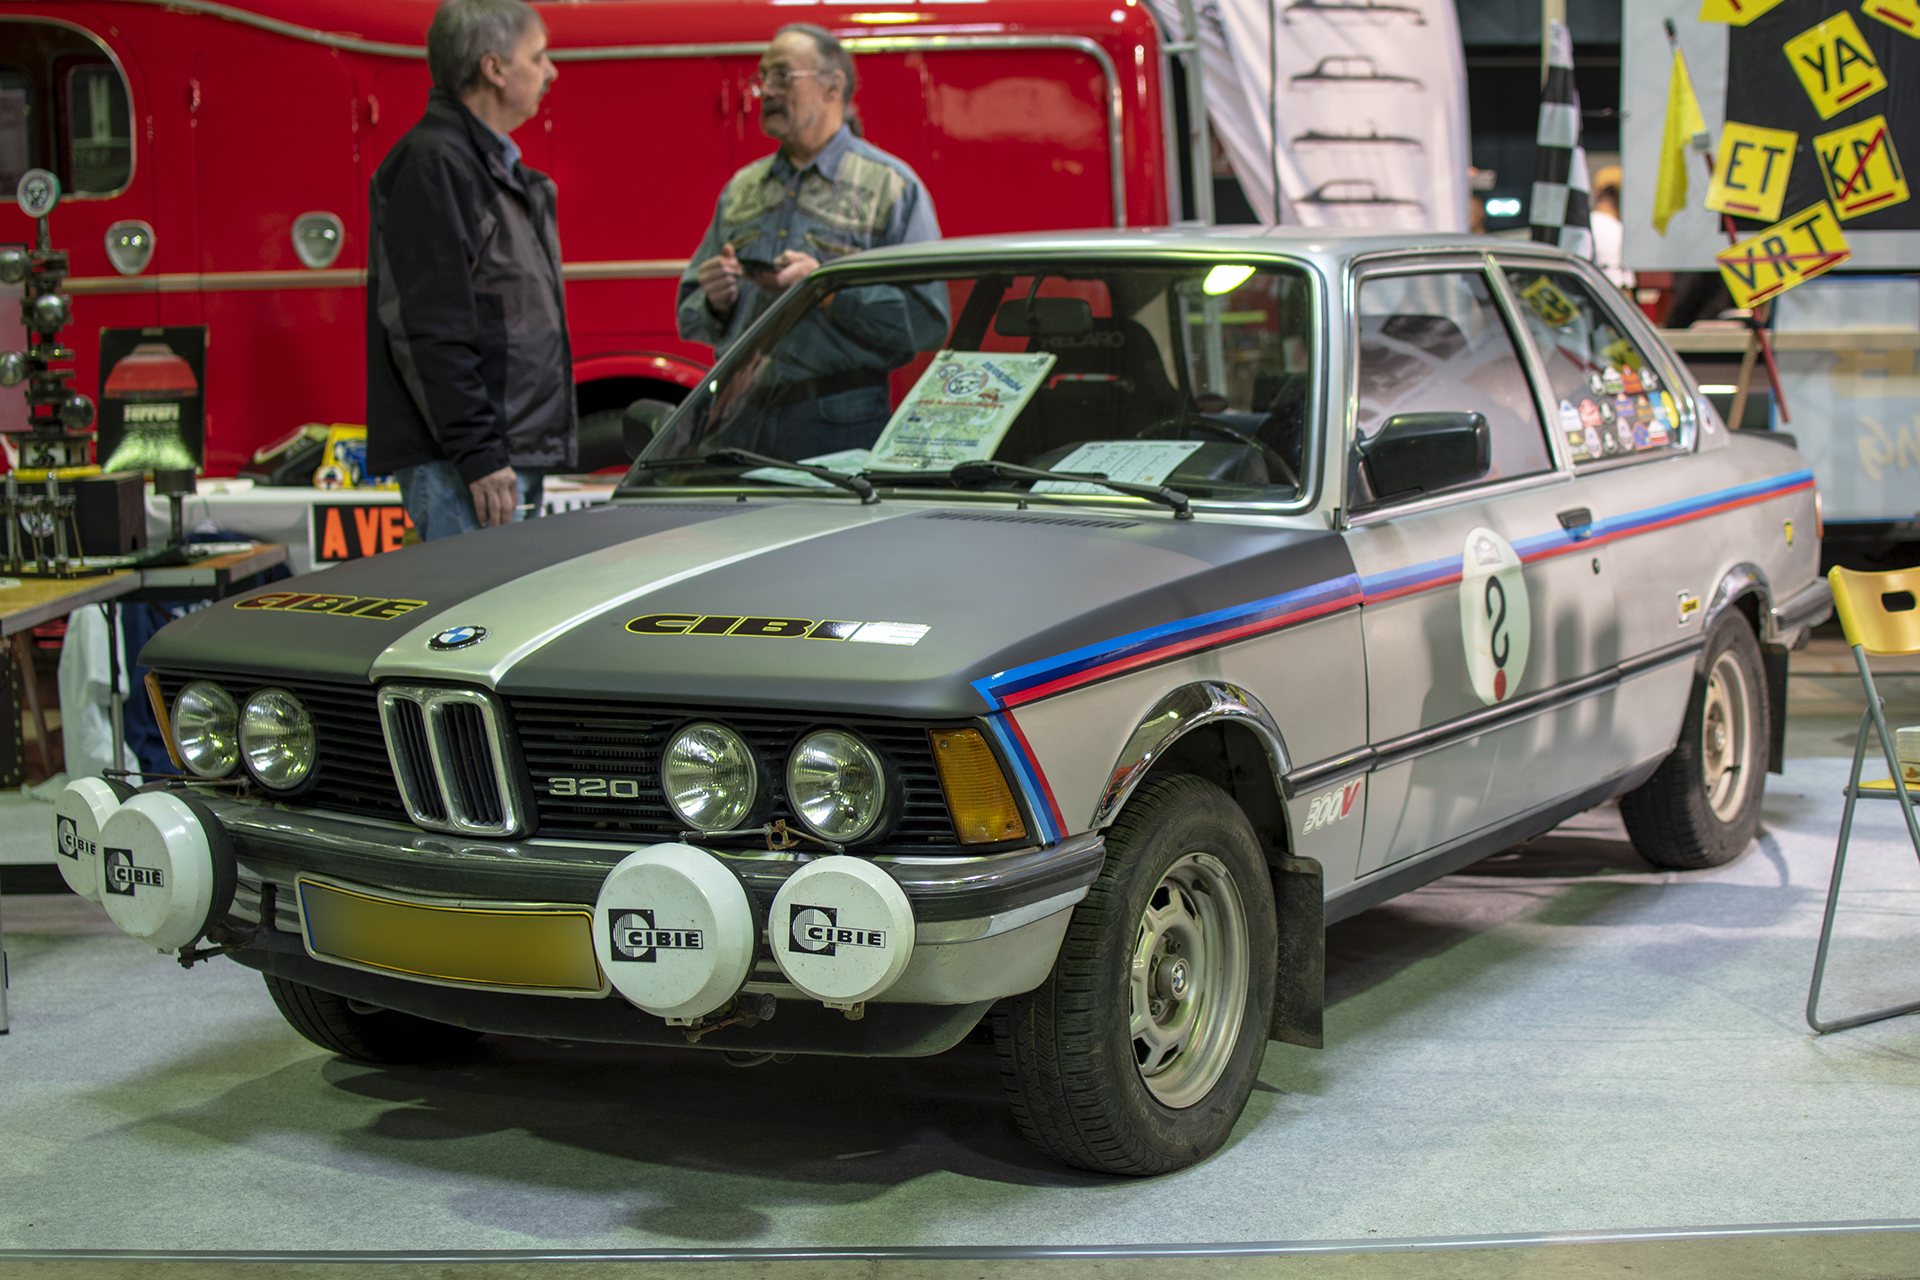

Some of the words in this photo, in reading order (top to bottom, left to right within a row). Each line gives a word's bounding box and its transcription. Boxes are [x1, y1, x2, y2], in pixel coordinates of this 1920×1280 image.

[1801, 35, 1877, 94] YA
[1724, 140, 1785, 195] ET
[1721, 213, 1826, 291] VRT
[322, 507, 350, 559] A
[353, 507, 414, 557] VE
[548, 778, 639, 798] 320
[1302, 777, 1364, 835] 300V
